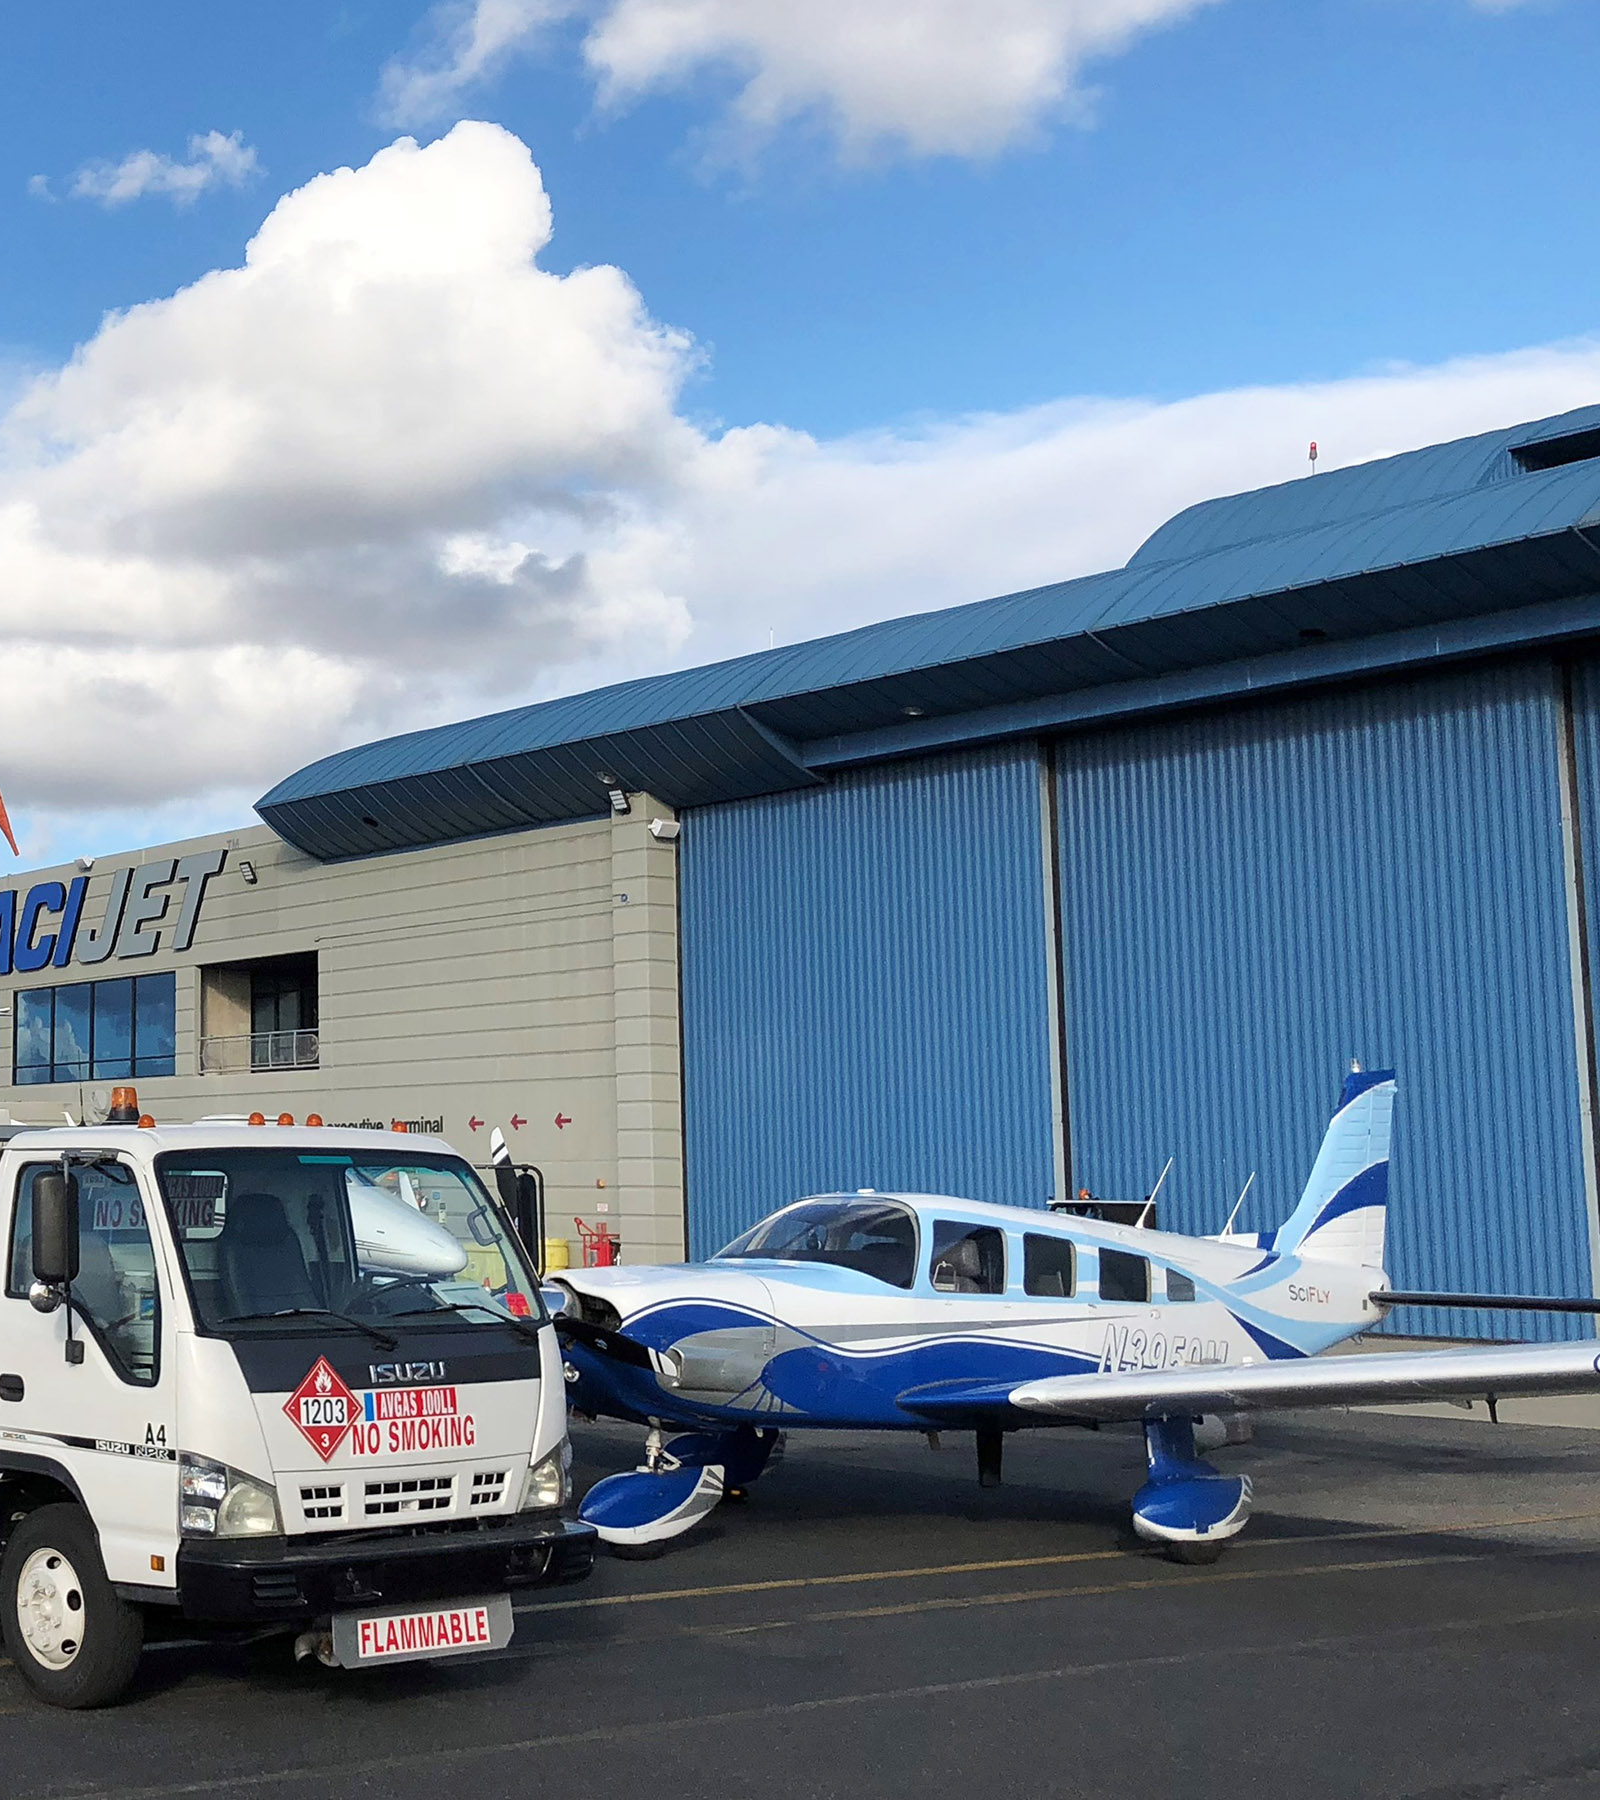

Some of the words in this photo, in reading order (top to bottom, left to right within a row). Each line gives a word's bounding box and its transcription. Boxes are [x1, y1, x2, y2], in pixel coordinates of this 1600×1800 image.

[327, 1118, 384, 1130] utive
[391, 1115, 443, 1133] minal
[368, 1361, 446, 1384] ISUZU
[302, 1398, 345, 1425] 1203
[380, 1391, 417, 1419] AVGAS
[421, 1389, 454, 1417] 100LL
[145, 1422, 167, 1447] A4
[320, 1432, 330, 1448] 3
[352, 1422, 381, 1455] NO
[388, 1414, 475, 1453] SMOKING
[96, 1440, 130, 1454] ISUZU
[134, 1444, 169, 1460] NPR
[360, 1609, 489, 1655] FLAMMABLE
